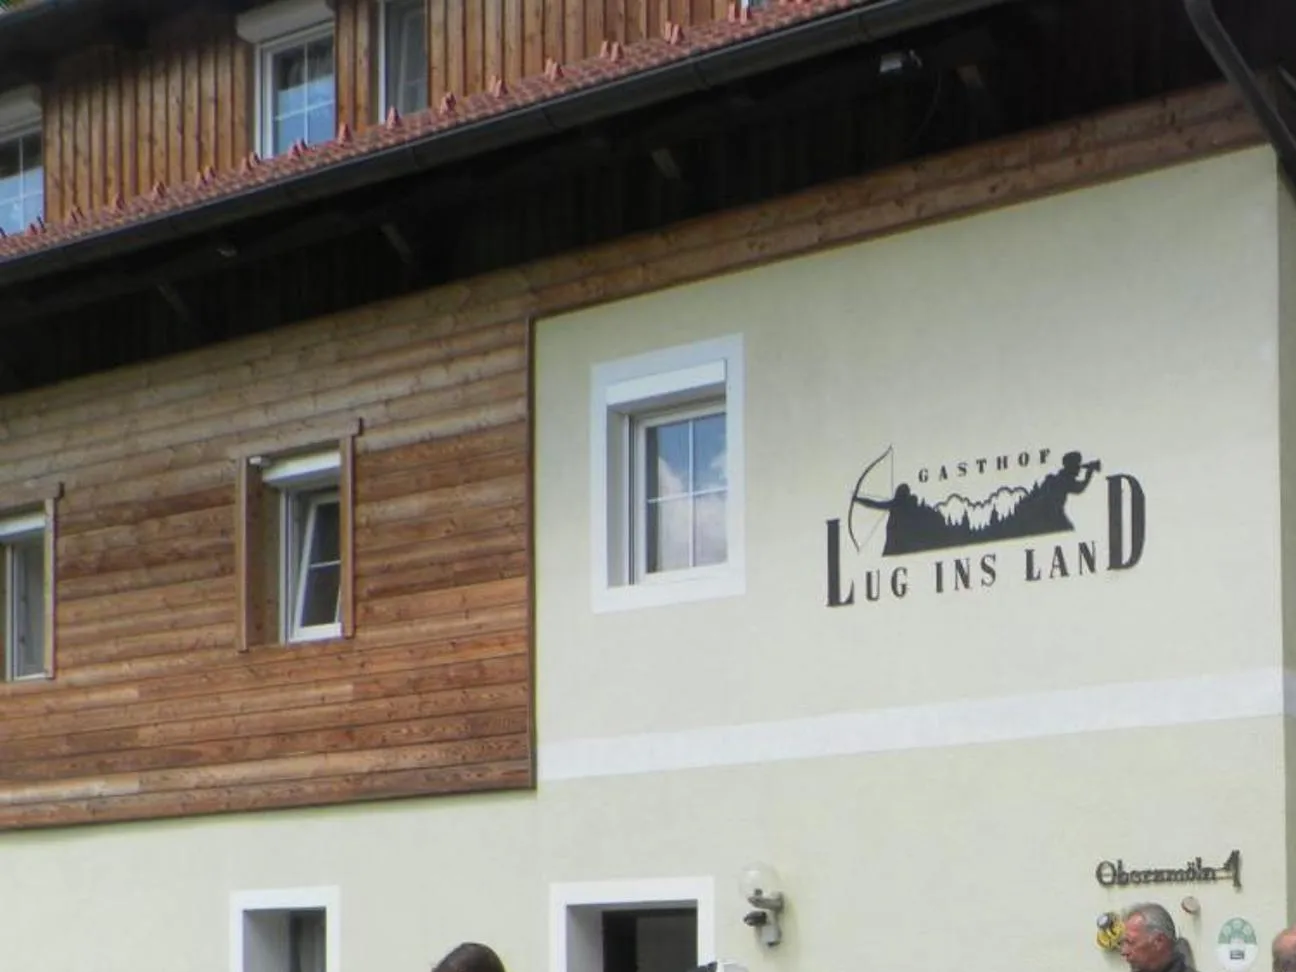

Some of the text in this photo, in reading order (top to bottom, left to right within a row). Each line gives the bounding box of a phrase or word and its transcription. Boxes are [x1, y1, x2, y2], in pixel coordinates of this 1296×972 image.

[918, 448, 1051, 484] GASTHOF
[826, 473, 1147, 608] LUG INS LAND
